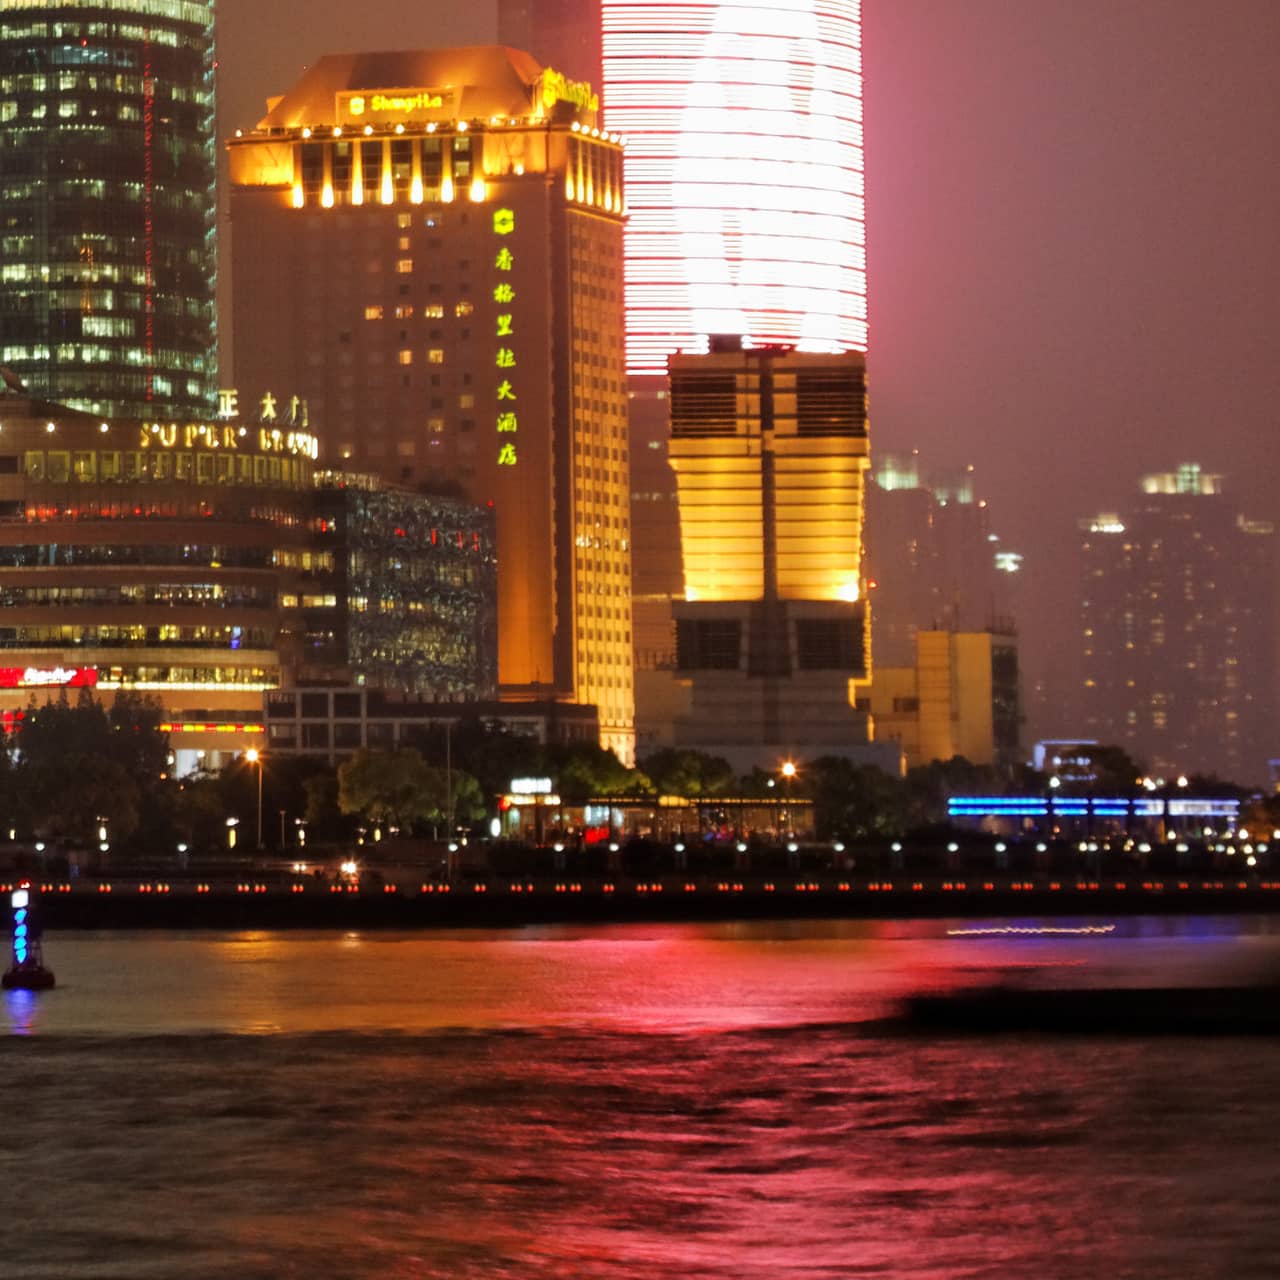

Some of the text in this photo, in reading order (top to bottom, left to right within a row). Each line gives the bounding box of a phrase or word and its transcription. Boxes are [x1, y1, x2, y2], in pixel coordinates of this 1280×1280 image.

[494, 247, 518, 466] 香格里拉大酒店
[140, 423, 238, 449] SUPER
